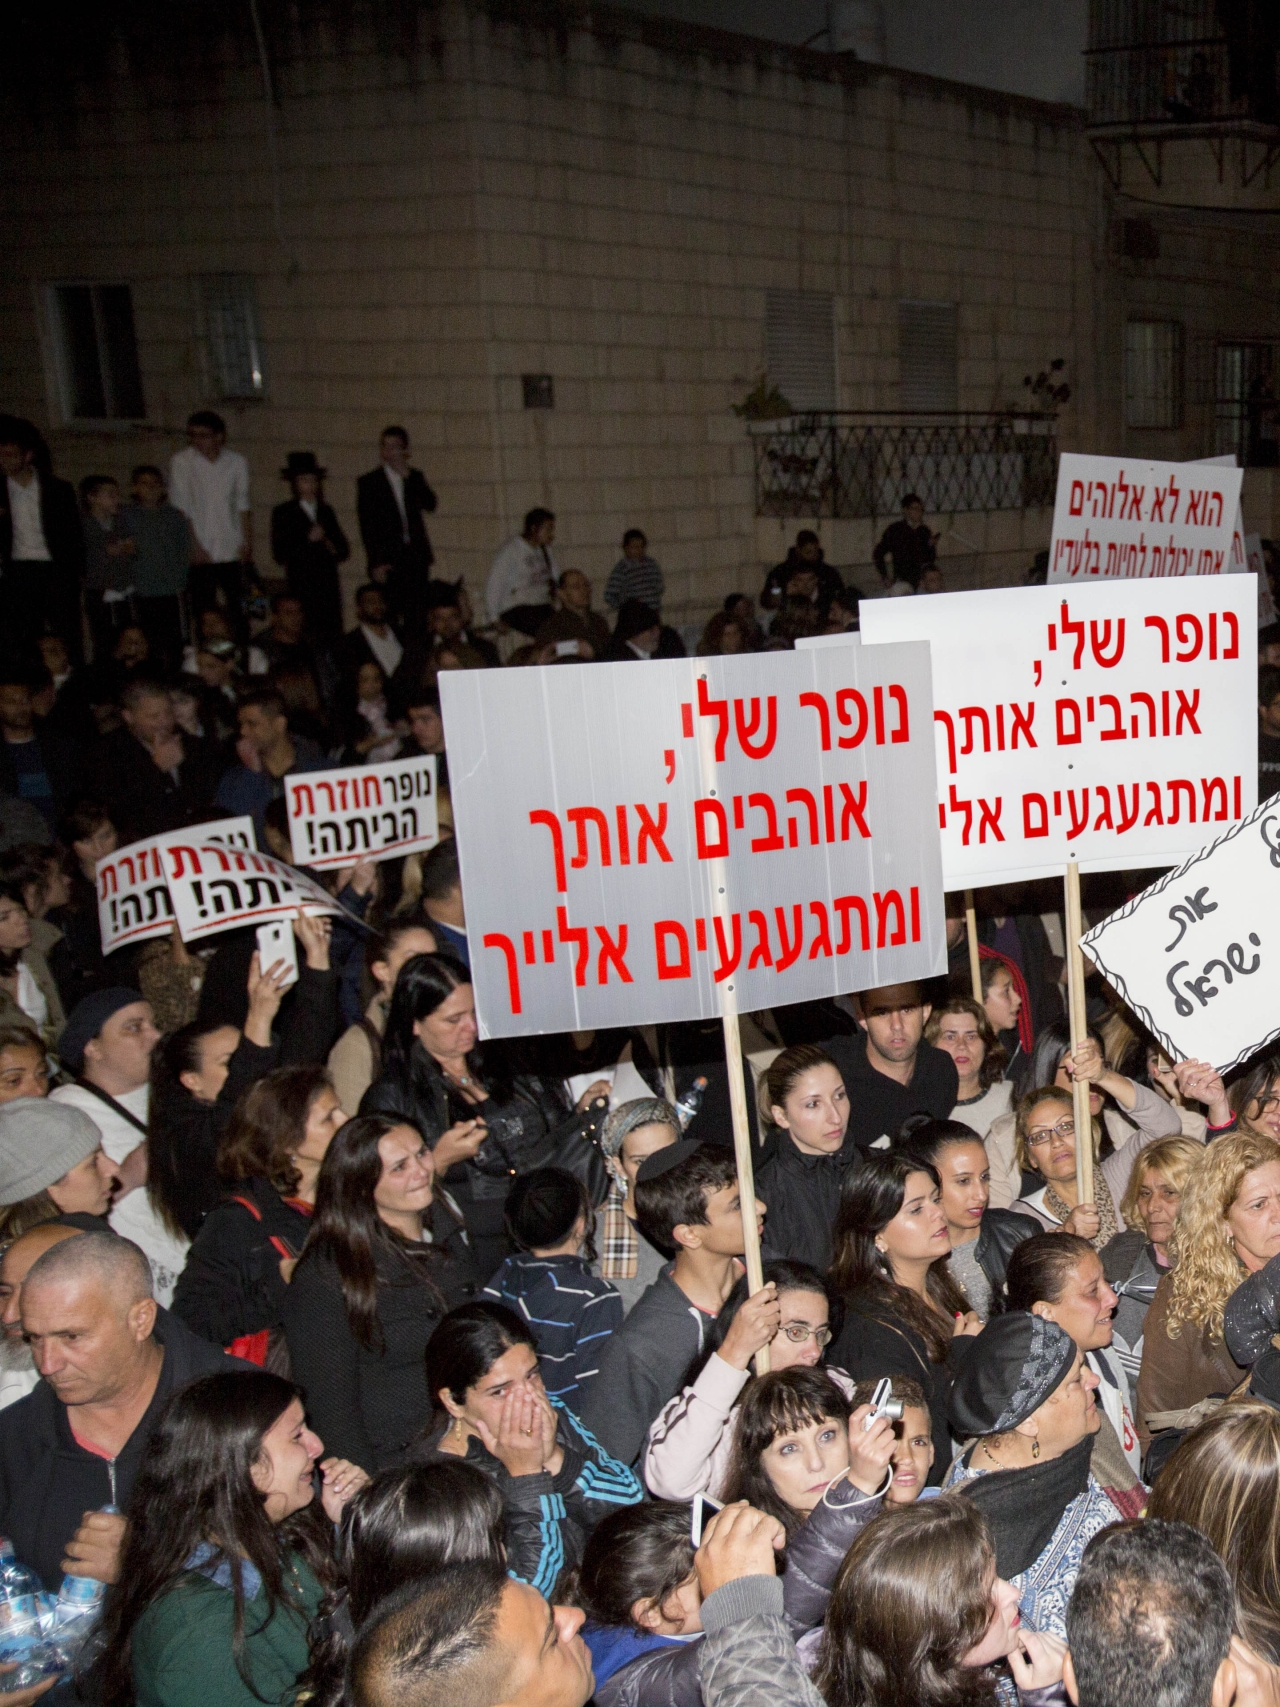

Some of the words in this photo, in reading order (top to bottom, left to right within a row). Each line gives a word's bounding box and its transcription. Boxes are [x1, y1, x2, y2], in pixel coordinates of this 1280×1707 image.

[1069, 470, 1145, 521] אלוהים
[1150, 474, 1180, 523] לא
[1185, 490, 1224, 527] הוא
[1053, 528, 1100, 577] בלעדיו
[1104, 532, 1147, 578] לחיות
[1149, 535, 1193, 578] יכולות
[1032, 604, 1126, 687] שלי,
[1144, 611, 1240, 664] נופר
[664, 678, 779, 785] שלי,
[798, 684, 910, 752] נופר
[934, 701, 1038, 774] אותך
[1055, 688, 1202, 746] אוהבים
[291, 775, 381, 818] חוזרת
[383, 768, 432, 803] נופר
[1022, 776, 1242, 841] ומתגעגעים
[307, 807, 418, 855] הביתה!
[528, 802, 674, 892] אותך
[694, 781, 872, 860] אוהבים
[100, 846, 161, 899] וזרת
[653, 886, 922, 984] ומתגעגעים
[1165, 886, 1219, 953] את
[483, 906, 635, 1014] אלייך
[1165, 932, 1261, 1018] ישראל
